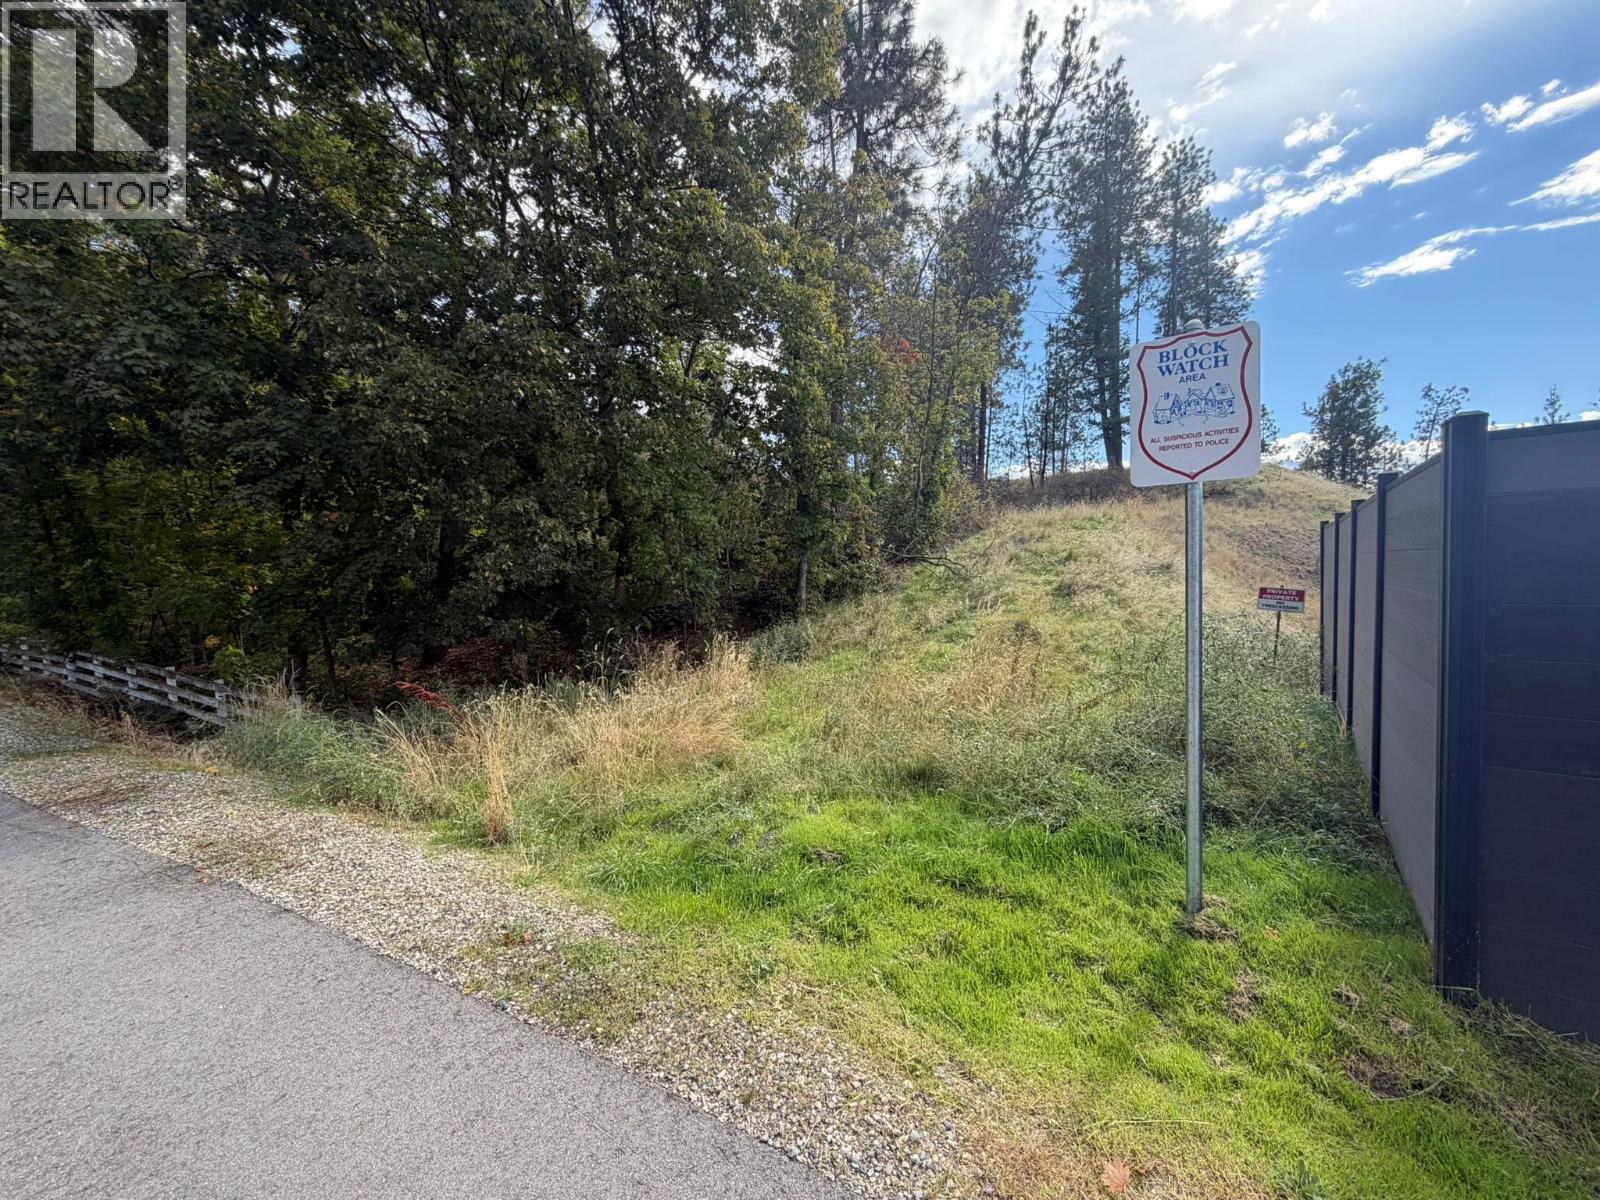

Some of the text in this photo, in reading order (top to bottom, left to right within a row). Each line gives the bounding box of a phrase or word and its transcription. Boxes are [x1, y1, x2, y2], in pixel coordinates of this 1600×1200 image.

[1158, 340, 1228, 363] BLOCK
[1157, 354, 1230, 377] WATCH
[1179, 373, 1206, 384] AREA
[1164, 432, 1202, 442] SUSPICIOUS
[1205, 427, 1240, 436] ACTIVITIES
[1159, 443, 1192, 452] REPORTED
[1206, 438, 1230, 446] POLICE
